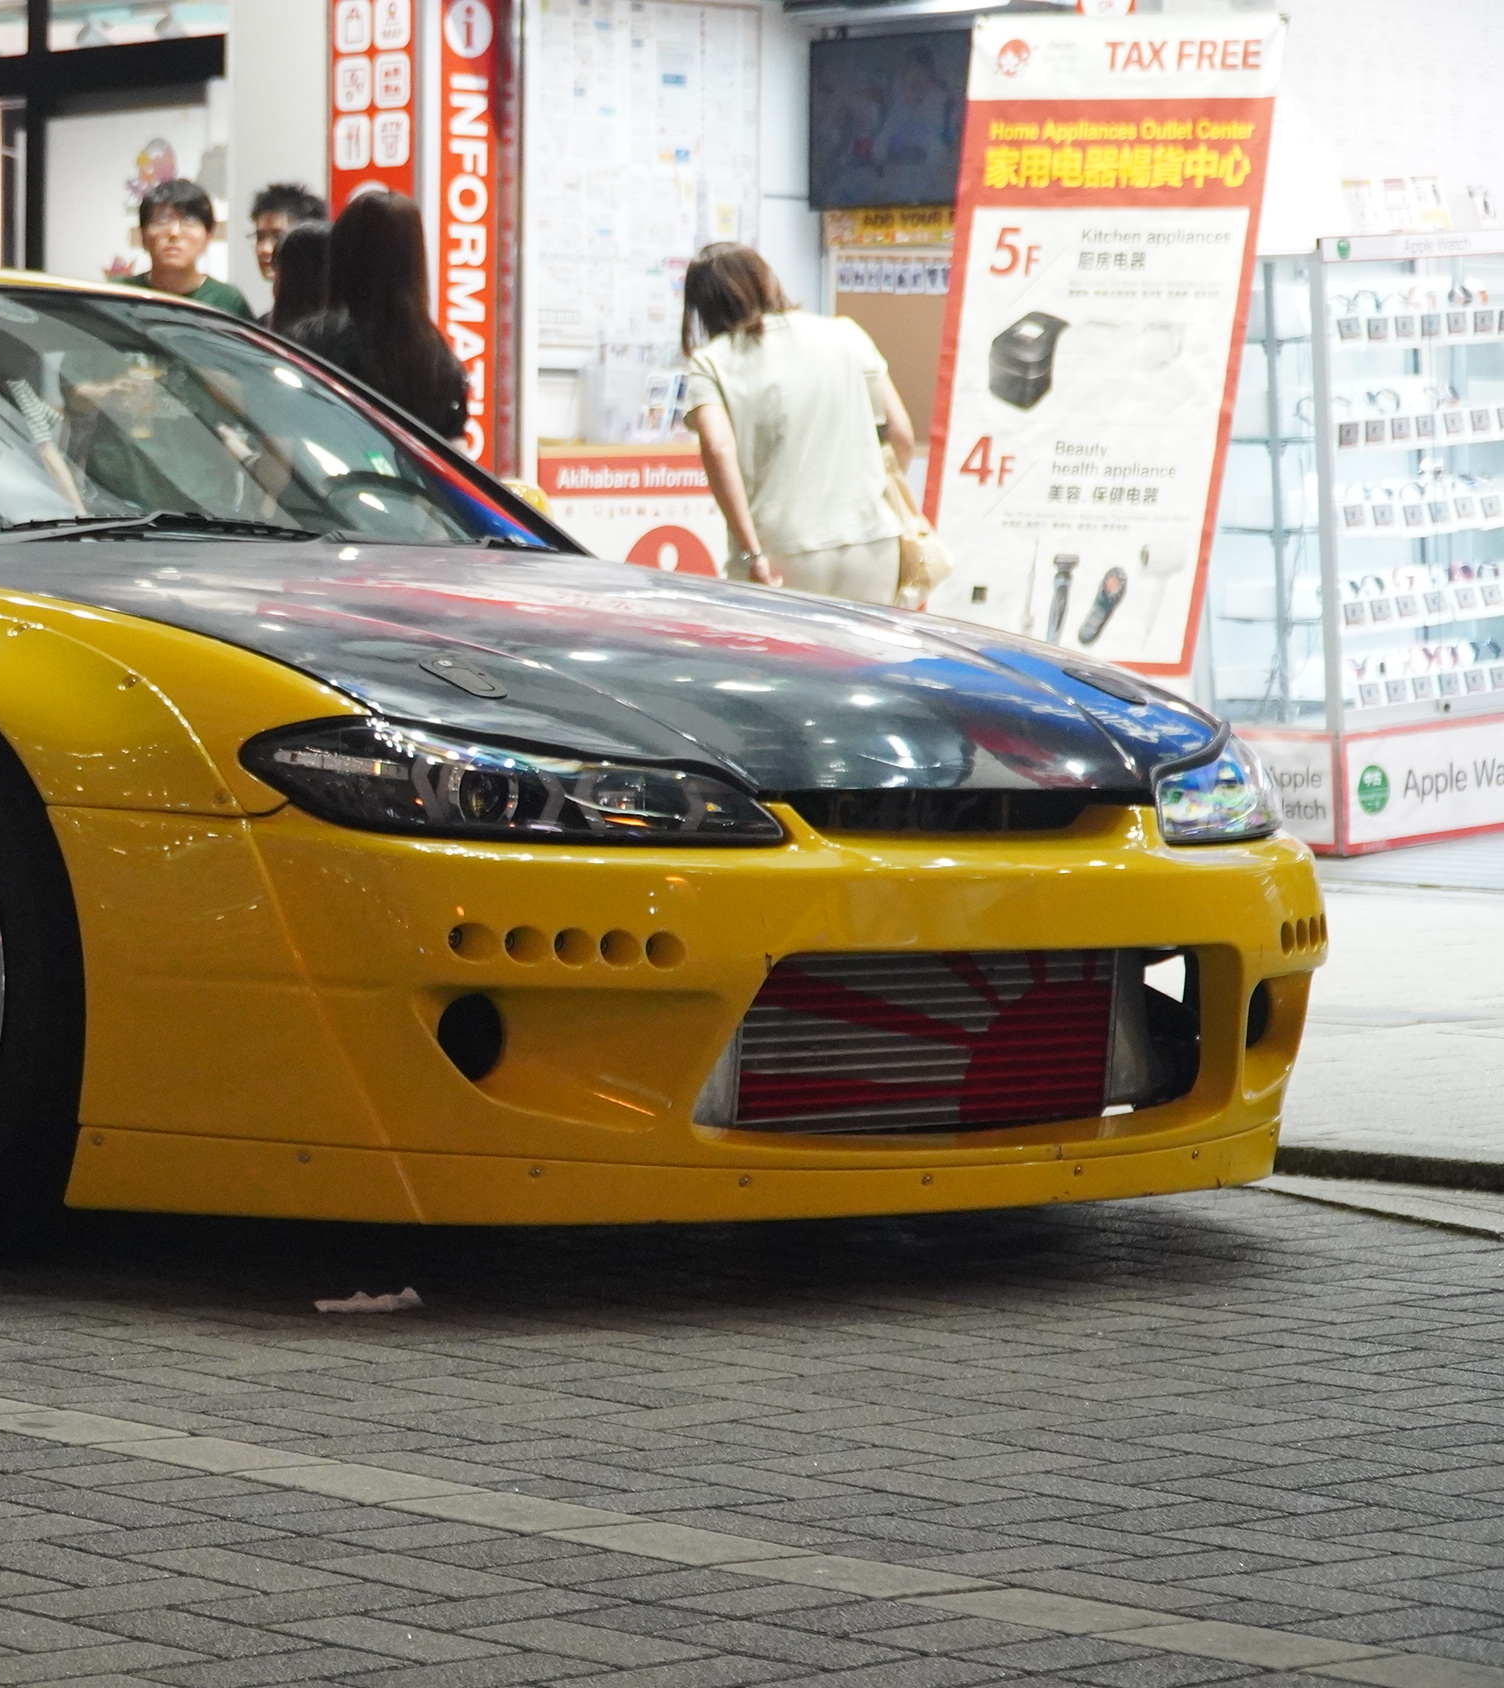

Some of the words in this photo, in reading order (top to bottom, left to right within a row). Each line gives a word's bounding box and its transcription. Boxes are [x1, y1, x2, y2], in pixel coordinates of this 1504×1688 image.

[1105, 40, 1168, 71] TAX
[1176, 38, 1262, 71] FREE
[990, 121, 1039, 141] Home
[1043, 120, 1138, 143] Appliances
[1140, 118, 1193, 140] Outlet
[1196, 118, 1255, 140] Center
[1081, 228, 1141, 245] Kitchen
[1146, 229, 1232, 247] appliances
[989, 226, 1042, 278] 5F
[1077, 250, 1148, 272] 厨房电器
[958, 435, 1016, 488] 4F
[1051, 461, 1099, 476] health
[1103, 463, 1177, 479] appliance
[557, 466, 640, 489] Akihabara
[1403, 761, 1468, 805] Apple
[1281, 798, 1327, 821] atch
